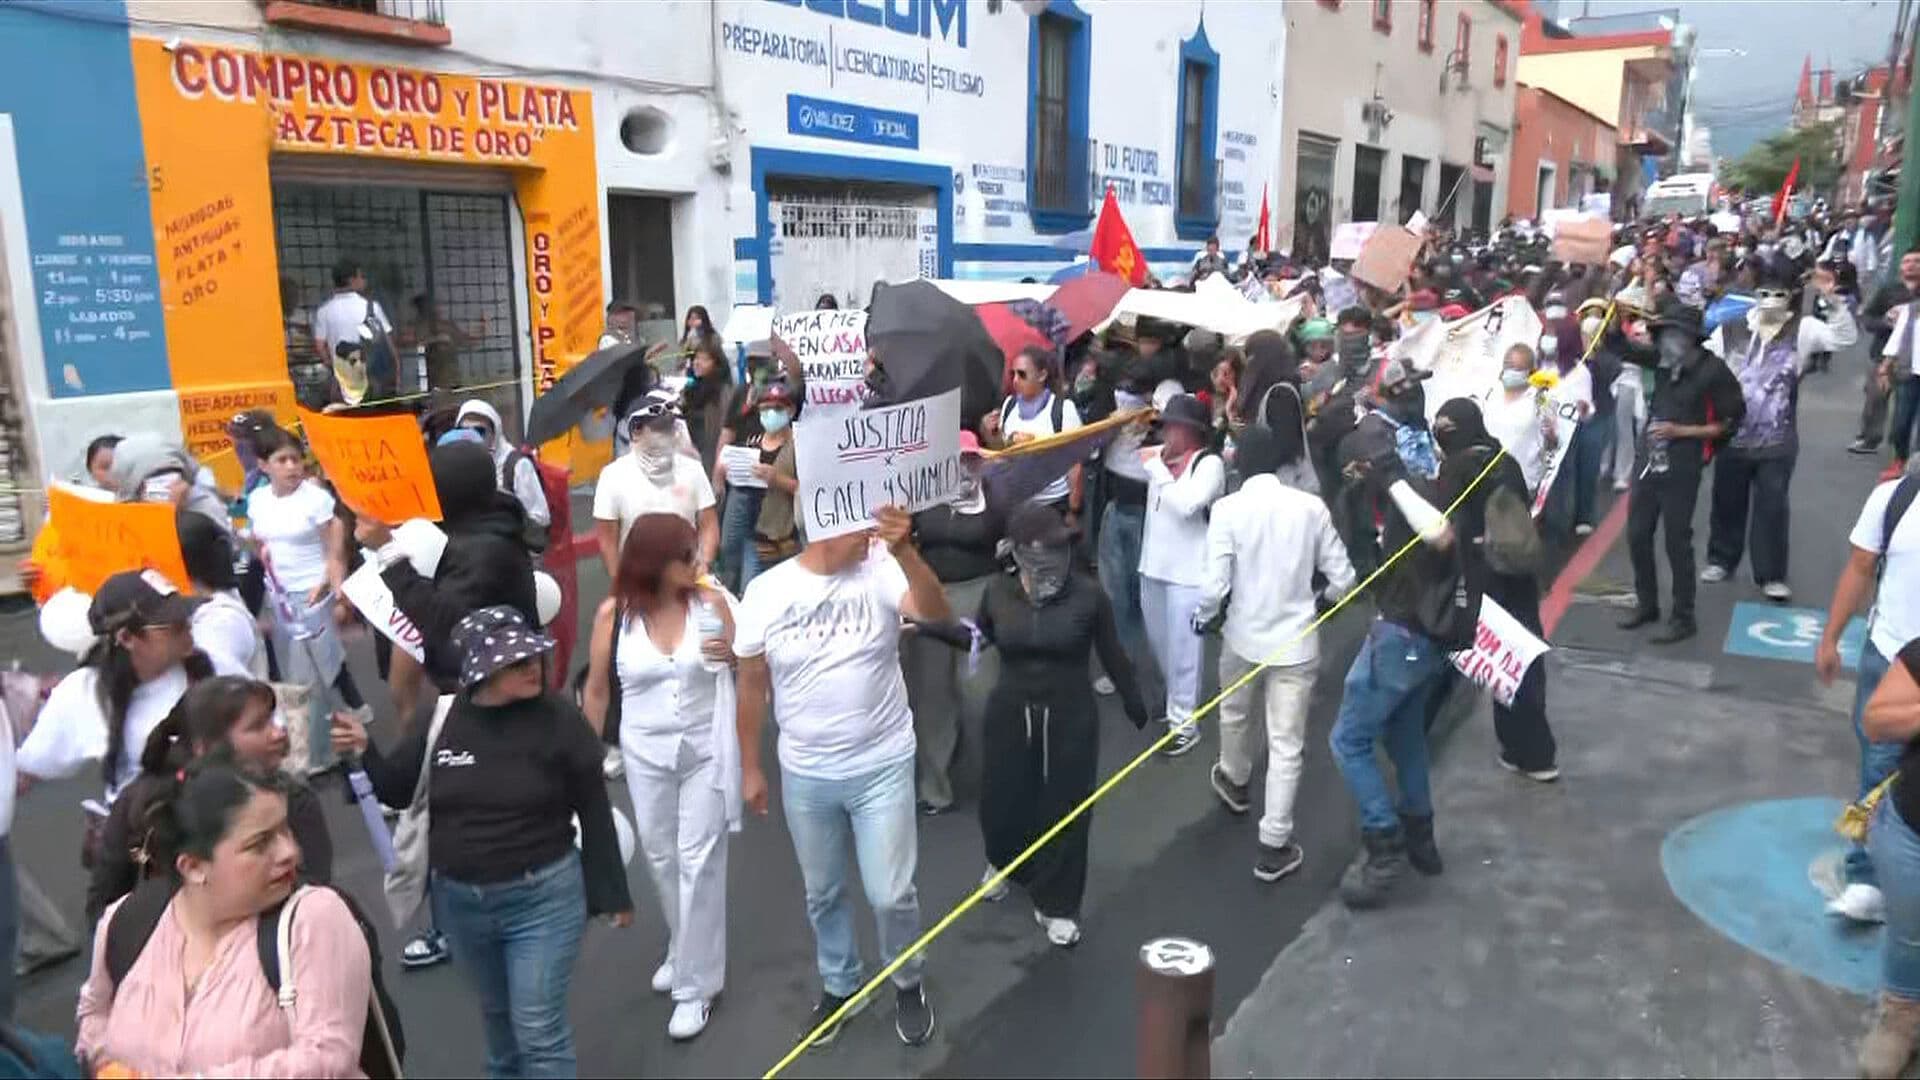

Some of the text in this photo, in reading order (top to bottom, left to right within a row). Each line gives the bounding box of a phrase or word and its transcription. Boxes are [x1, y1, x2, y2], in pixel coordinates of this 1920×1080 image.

[721, 21, 828, 67] PREPARATORIA
[834, 42, 927, 86] LICENCIATURAS
[930, 63, 985, 98] ESTILISMO
[173, 43, 578, 129] COMPRO ORO Y PLATA
[430, 122, 465, 153] DE
[1104, 143, 1158, 176] TU FUTURO
[182, 279, 218, 305] ORO
[798, 335, 820, 357] EN
[821, 332, 865, 354] CASA
[837, 404, 926, 451] JUSTICIA
